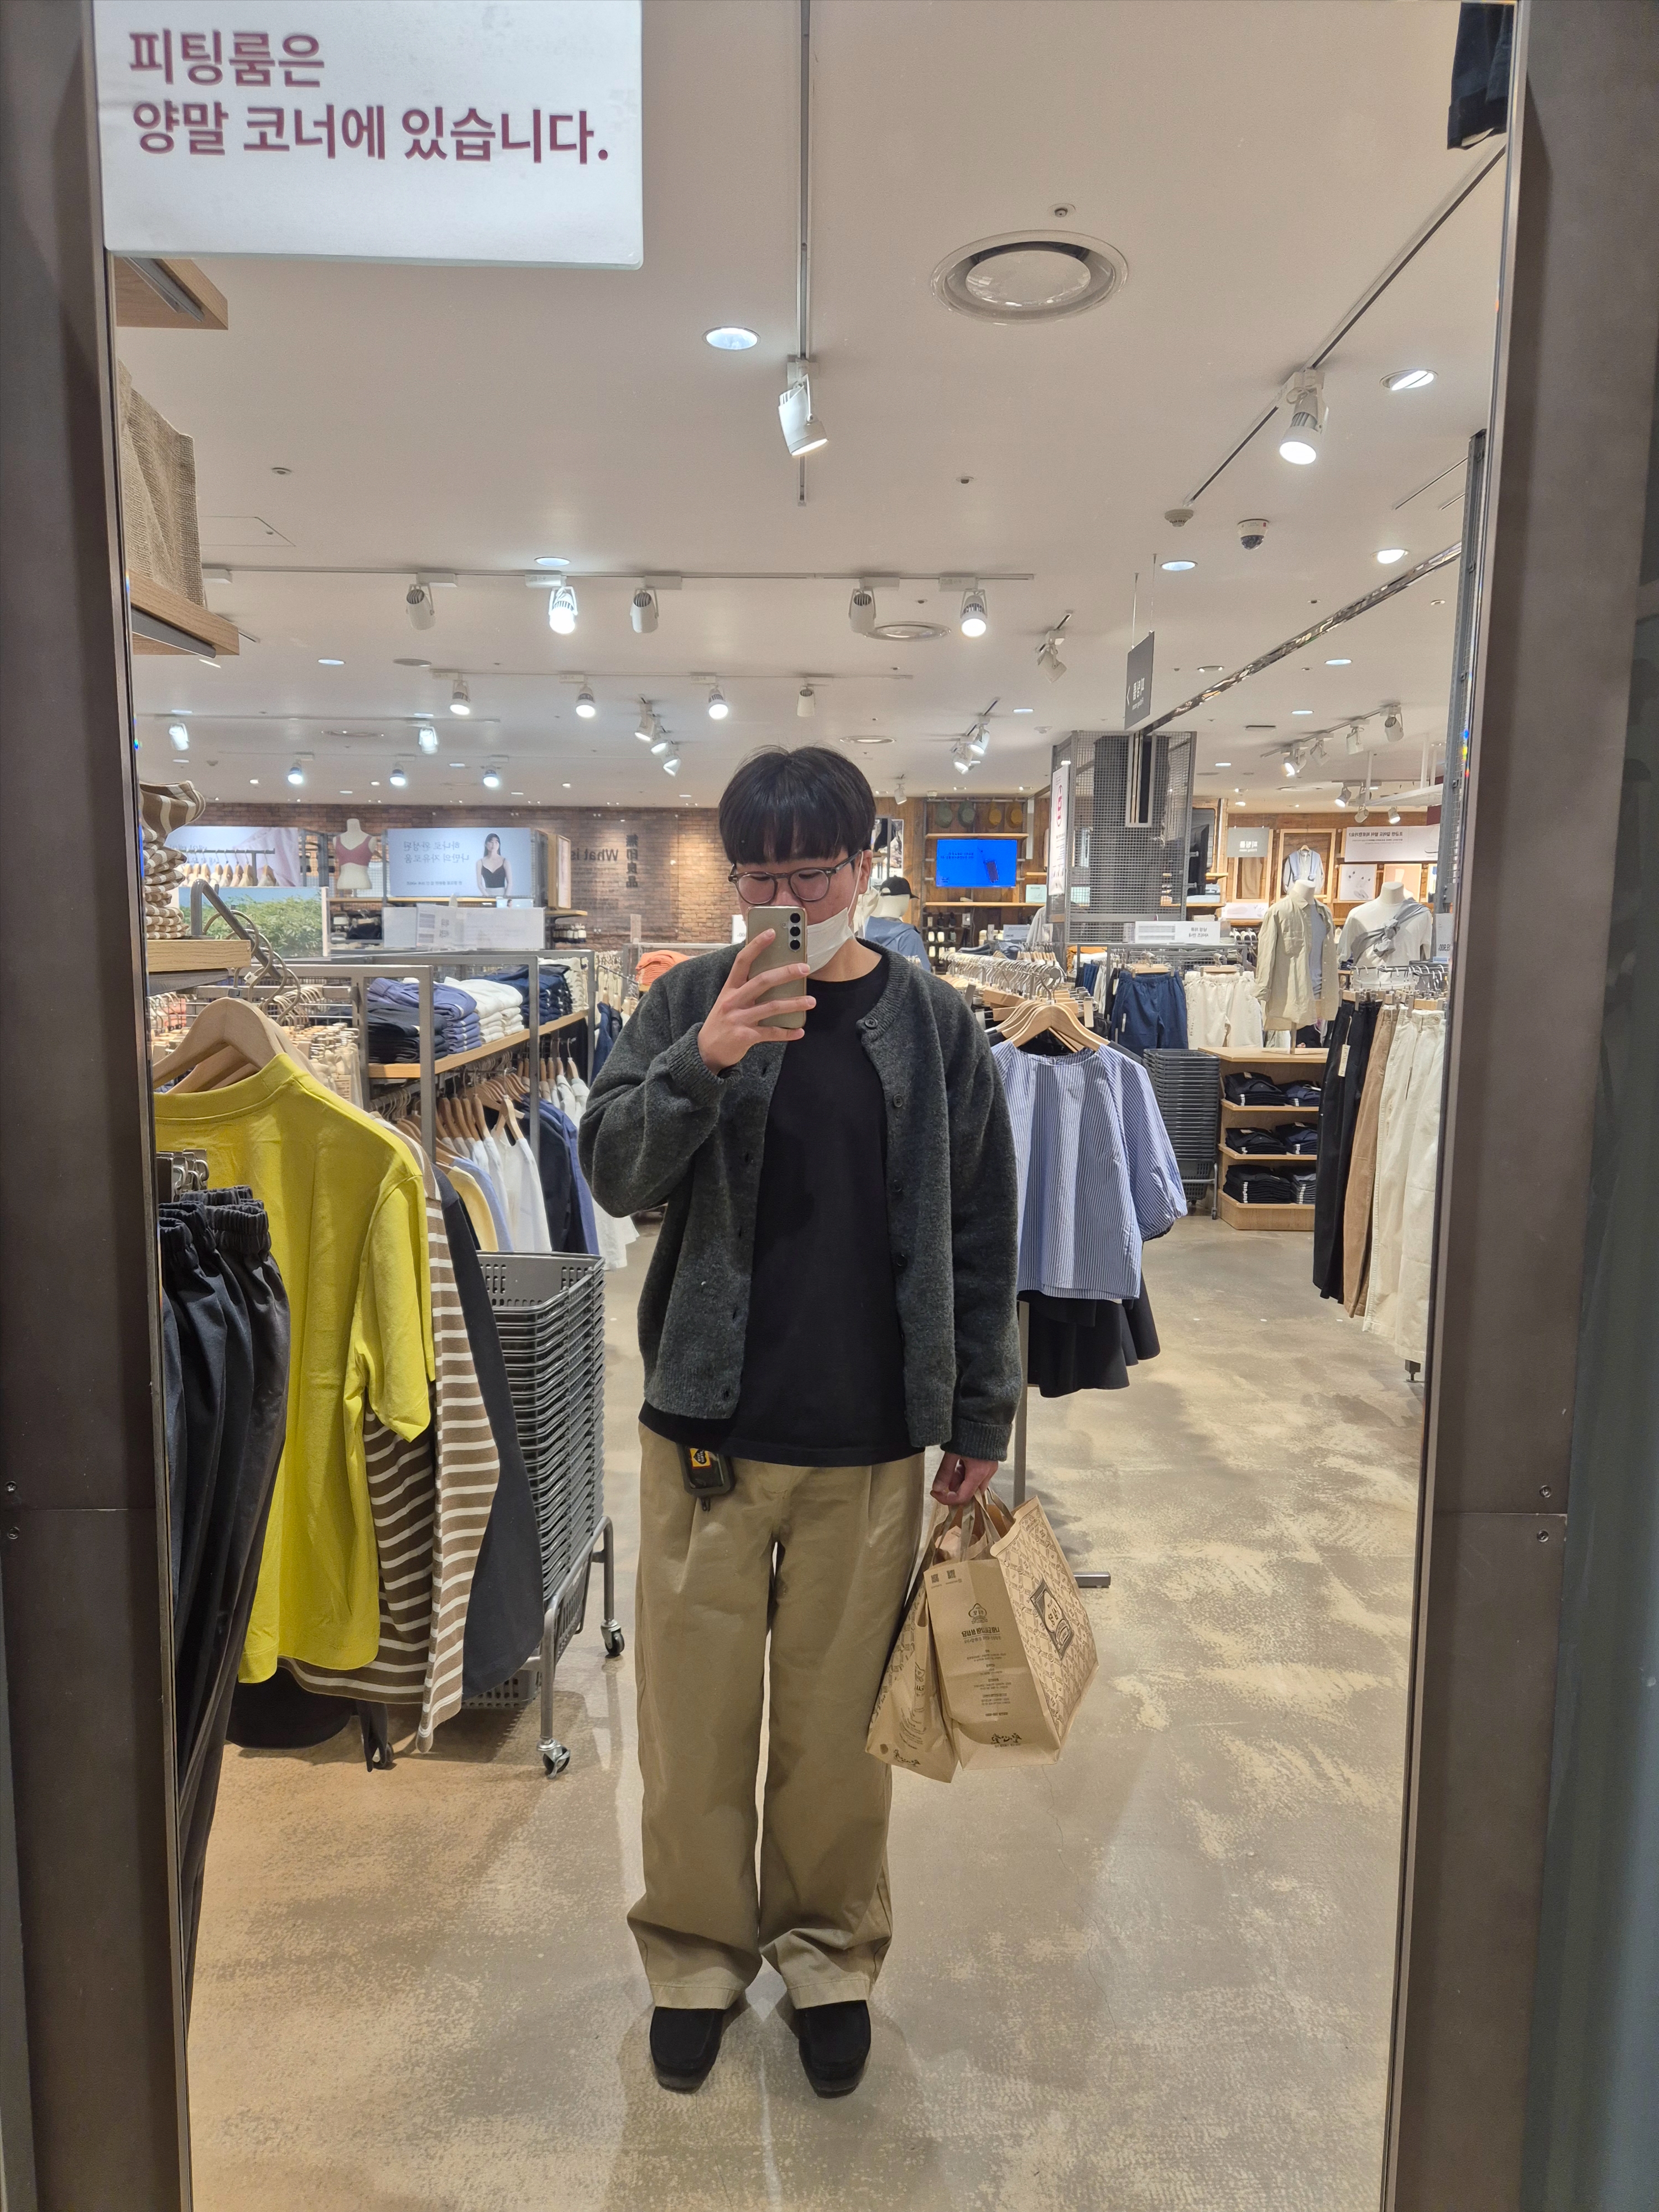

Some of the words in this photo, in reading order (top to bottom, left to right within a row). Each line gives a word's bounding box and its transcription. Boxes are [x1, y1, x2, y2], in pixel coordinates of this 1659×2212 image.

[129, 29, 326, 87] 피팅룸은
[133, 100, 229, 156] 양말
[243, 104, 386, 160] 코너에
[401, 107, 609, 165] 있습니다.
